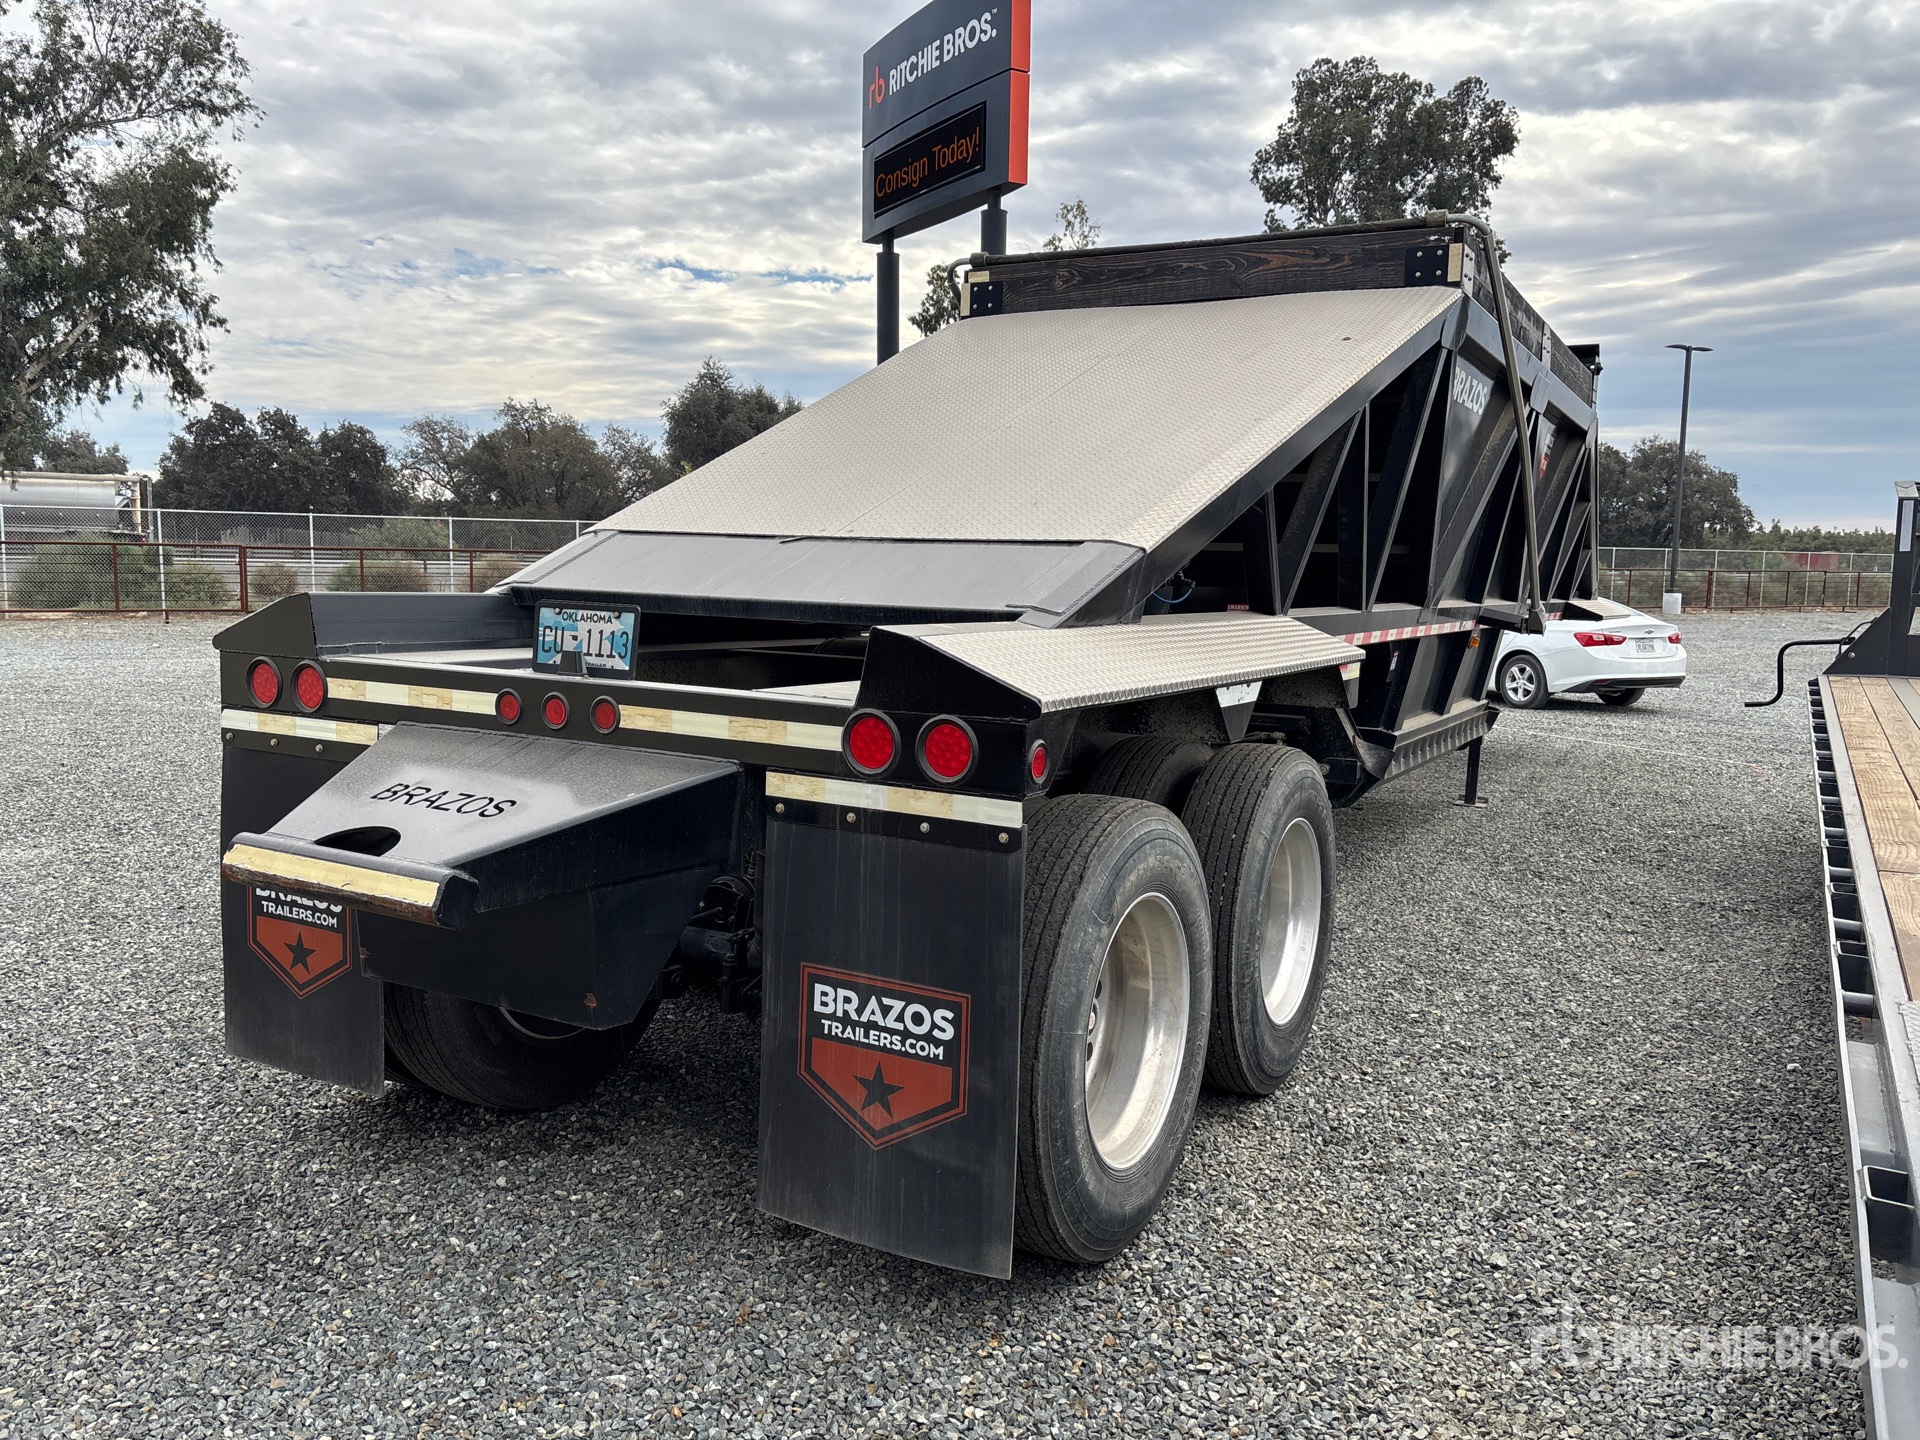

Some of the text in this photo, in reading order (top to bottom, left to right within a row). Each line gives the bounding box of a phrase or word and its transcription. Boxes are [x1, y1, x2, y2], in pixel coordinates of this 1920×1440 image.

[889, 39, 940, 95] RITCHIE
[943, 12, 997, 63] BROS.
[875, 126, 980, 198] Consign Today!
[562, 611, 613, 624] OKLAHOMA
[370, 783, 517, 818] BRAZOS
[261, 900, 337, 928] TRAILERS.COM
[813, 983, 955, 1041] BRAZOS
[821, 1019, 944, 1060] TRAILERS.COM
